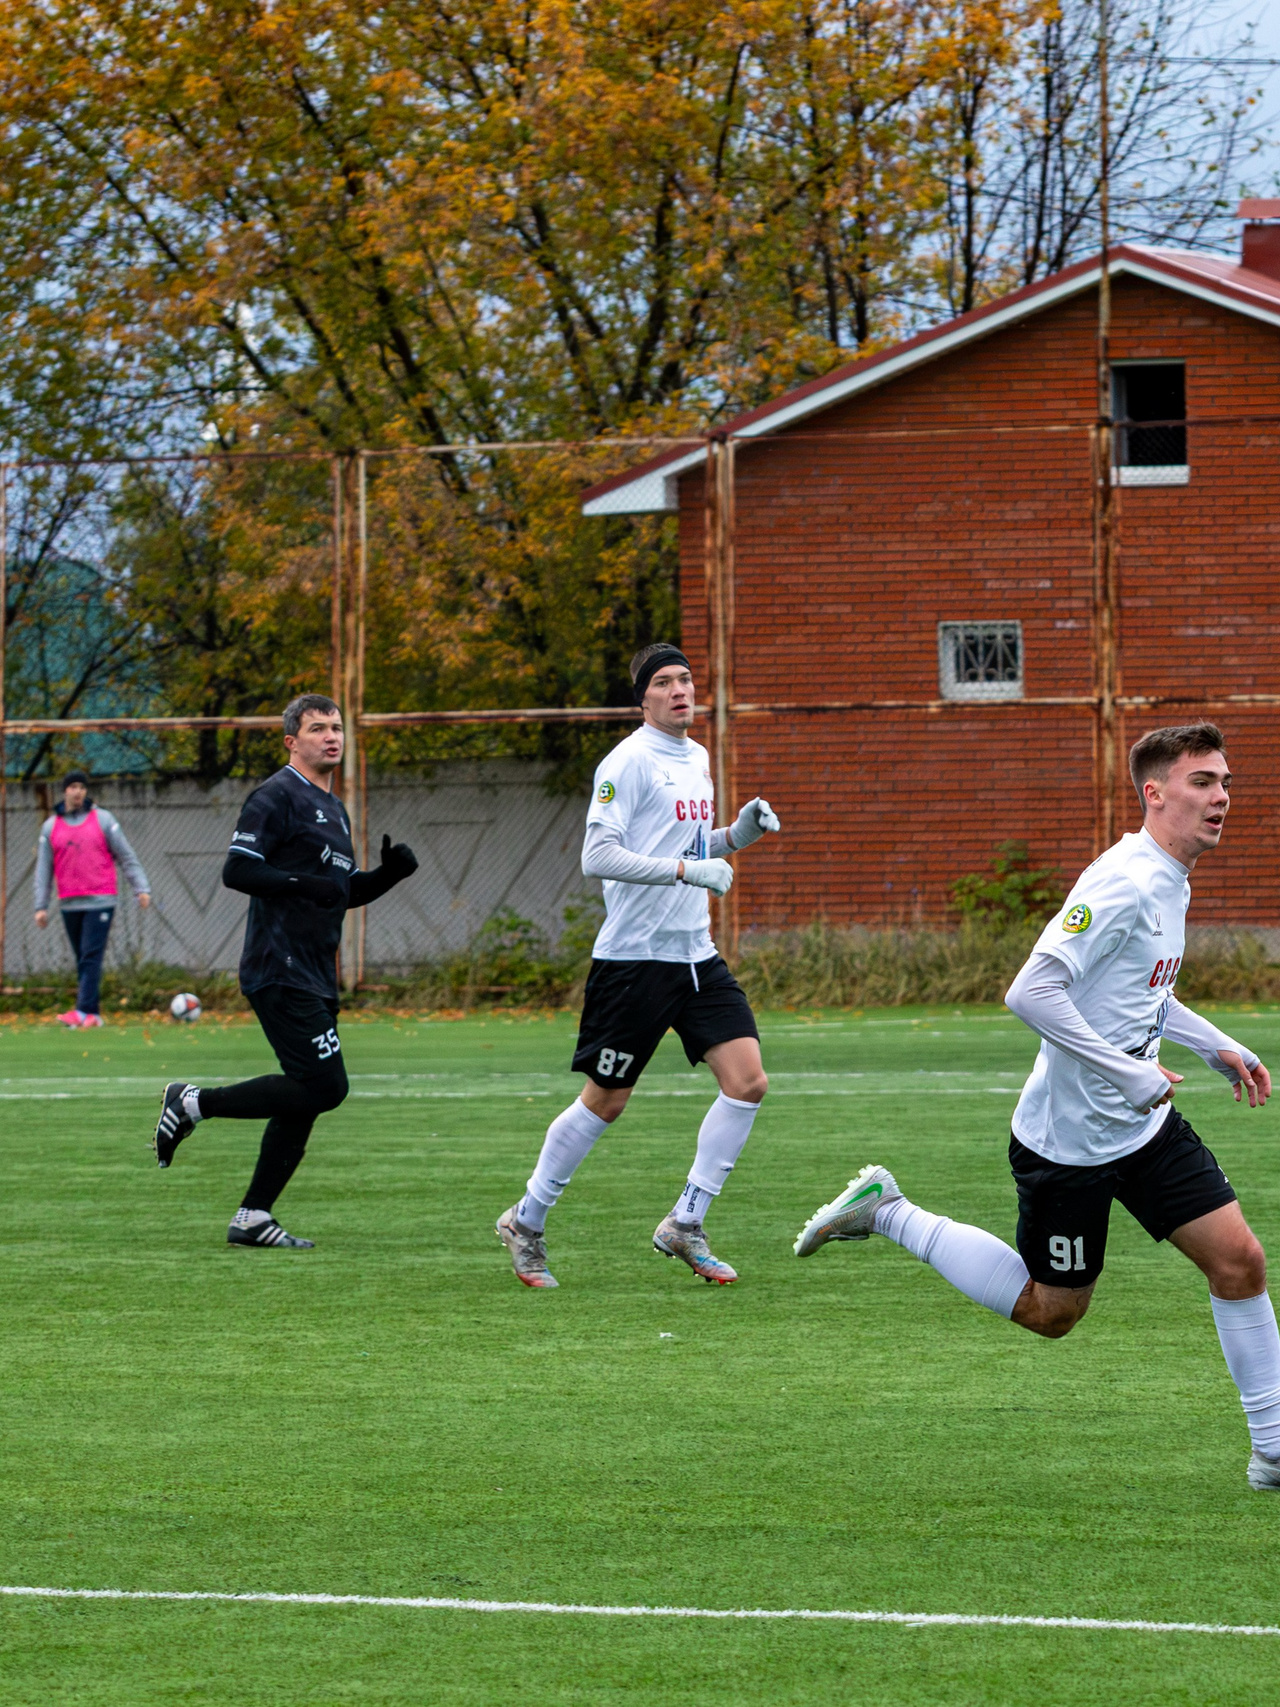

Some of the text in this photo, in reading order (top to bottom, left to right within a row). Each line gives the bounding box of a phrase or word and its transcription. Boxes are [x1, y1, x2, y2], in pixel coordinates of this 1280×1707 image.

[311, 1027, 340, 1059] 35
[597, 1047, 635, 1078] 87
[1049, 1235, 1086, 1271] 91
